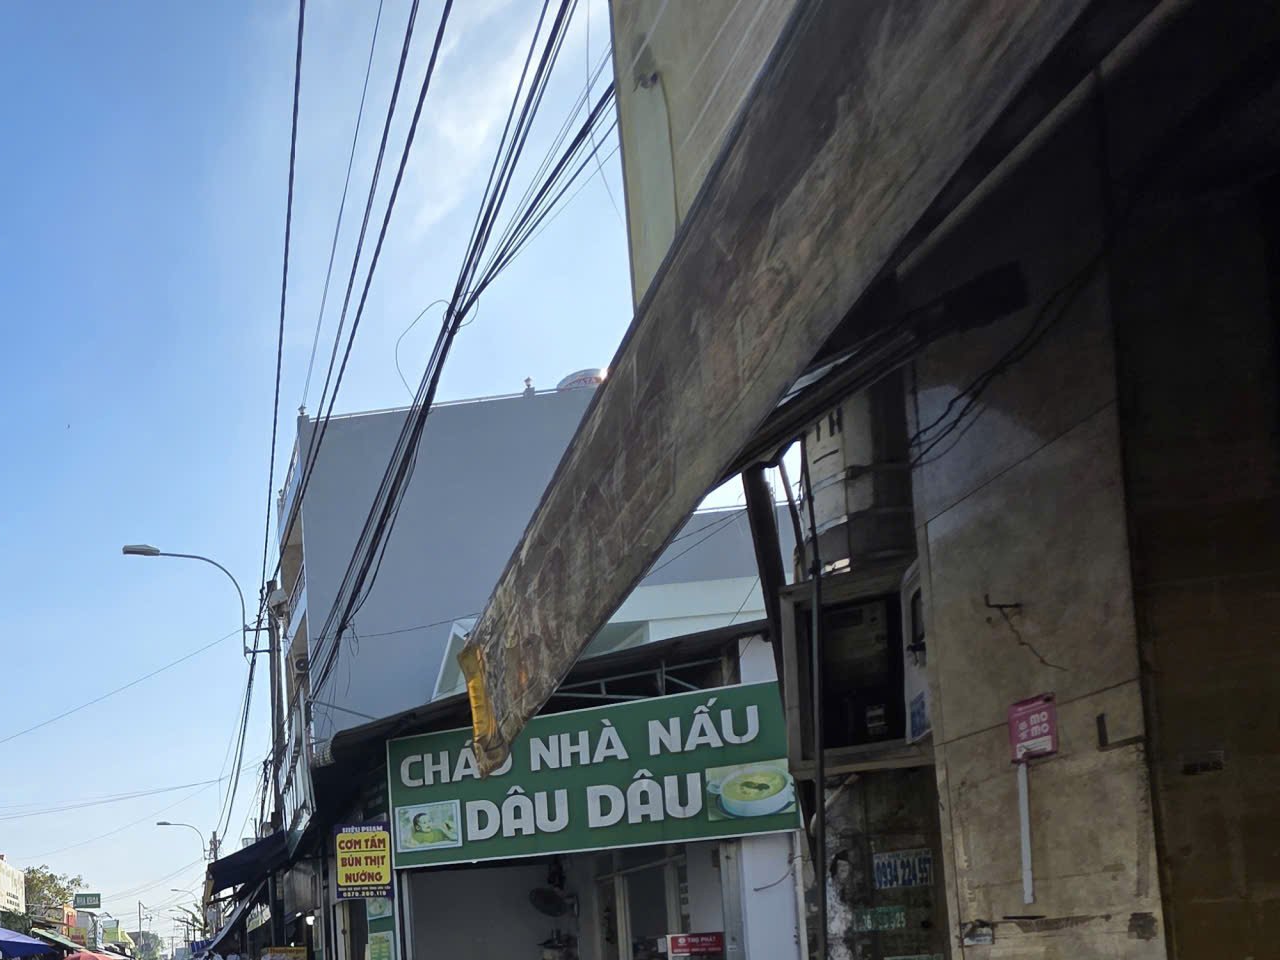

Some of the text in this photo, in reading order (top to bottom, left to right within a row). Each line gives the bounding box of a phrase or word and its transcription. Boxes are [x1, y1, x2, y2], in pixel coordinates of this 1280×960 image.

[530, 719, 628, 772] NHÀ
[648, 698, 761, 756] NẤU
[465, 768, 703, 842] DÂU DÂU
[338, 838, 362, 850] CƠM
[341, 854, 386, 868] BÚN THỊT
